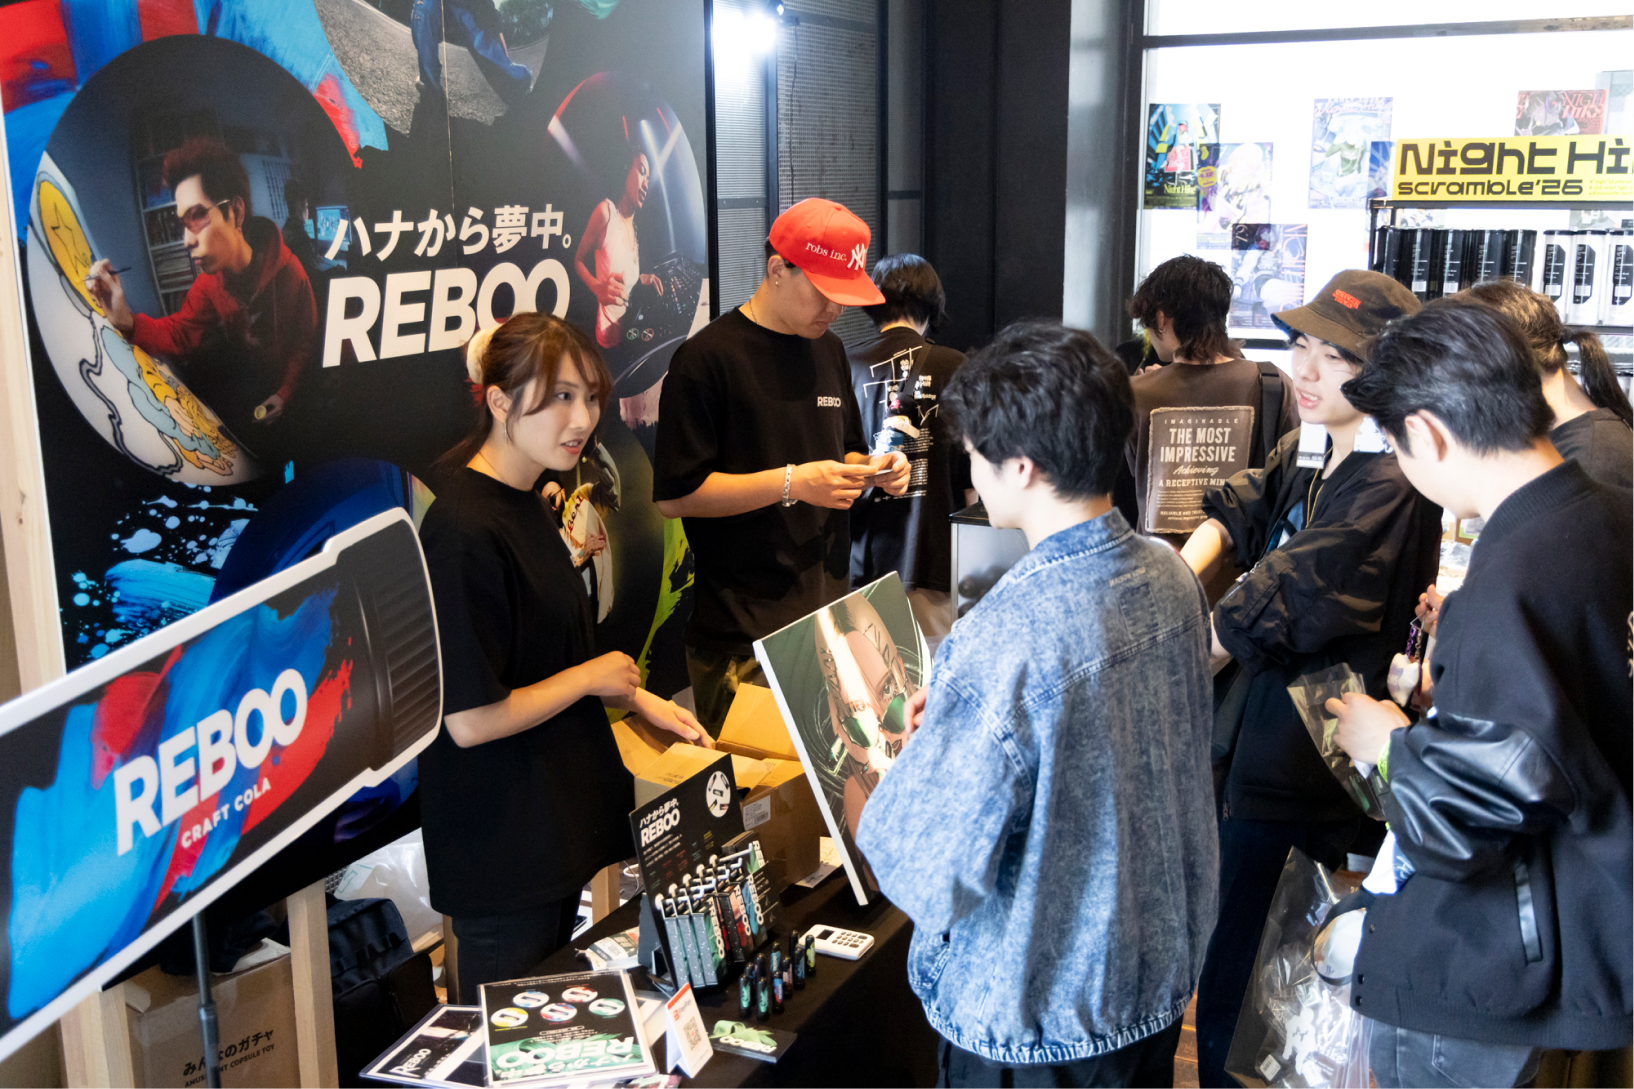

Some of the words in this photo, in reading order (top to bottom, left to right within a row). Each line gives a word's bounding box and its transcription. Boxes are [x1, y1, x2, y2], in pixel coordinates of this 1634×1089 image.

[1399, 140, 1558, 175] Night
[1567, 138, 1634, 175] Hi
[1398, 179, 1583, 196] scramble'26
[324, 203, 572, 262] ハナから夢中。
[805, 242, 829, 257] robs
[829, 249, 848, 262] inc.
[322, 258, 571, 369] REBOO
[817, 396, 842, 408] REBOO
[1169, 428, 1192, 445] THE
[1196, 427, 1232, 445] MOST
[1160, 446, 1237, 463] IMPRESSIVE
[1173, 464, 1220, 477] Achieving
[1158, 479, 1165, 487] A
[1165, 478, 1208, 488] RECEPTIVE
[1209, 478, 1228, 487] MIN
[113, 668, 308, 857] REBOO
[181, 803, 230, 849] CRAFT
[234, 777, 272, 812] COLA
[640, 808, 681, 848] REBOO
[752, 840, 766, 869] REB
[733, 884, 752, 936] REBOO
[746, 873, 765, 926] REBOO
[184, 1064, 229, 1088] AMUSNT
[261, 1043, 275, 1054] TOY
[496, 1036, 634, 1068] REBOO
